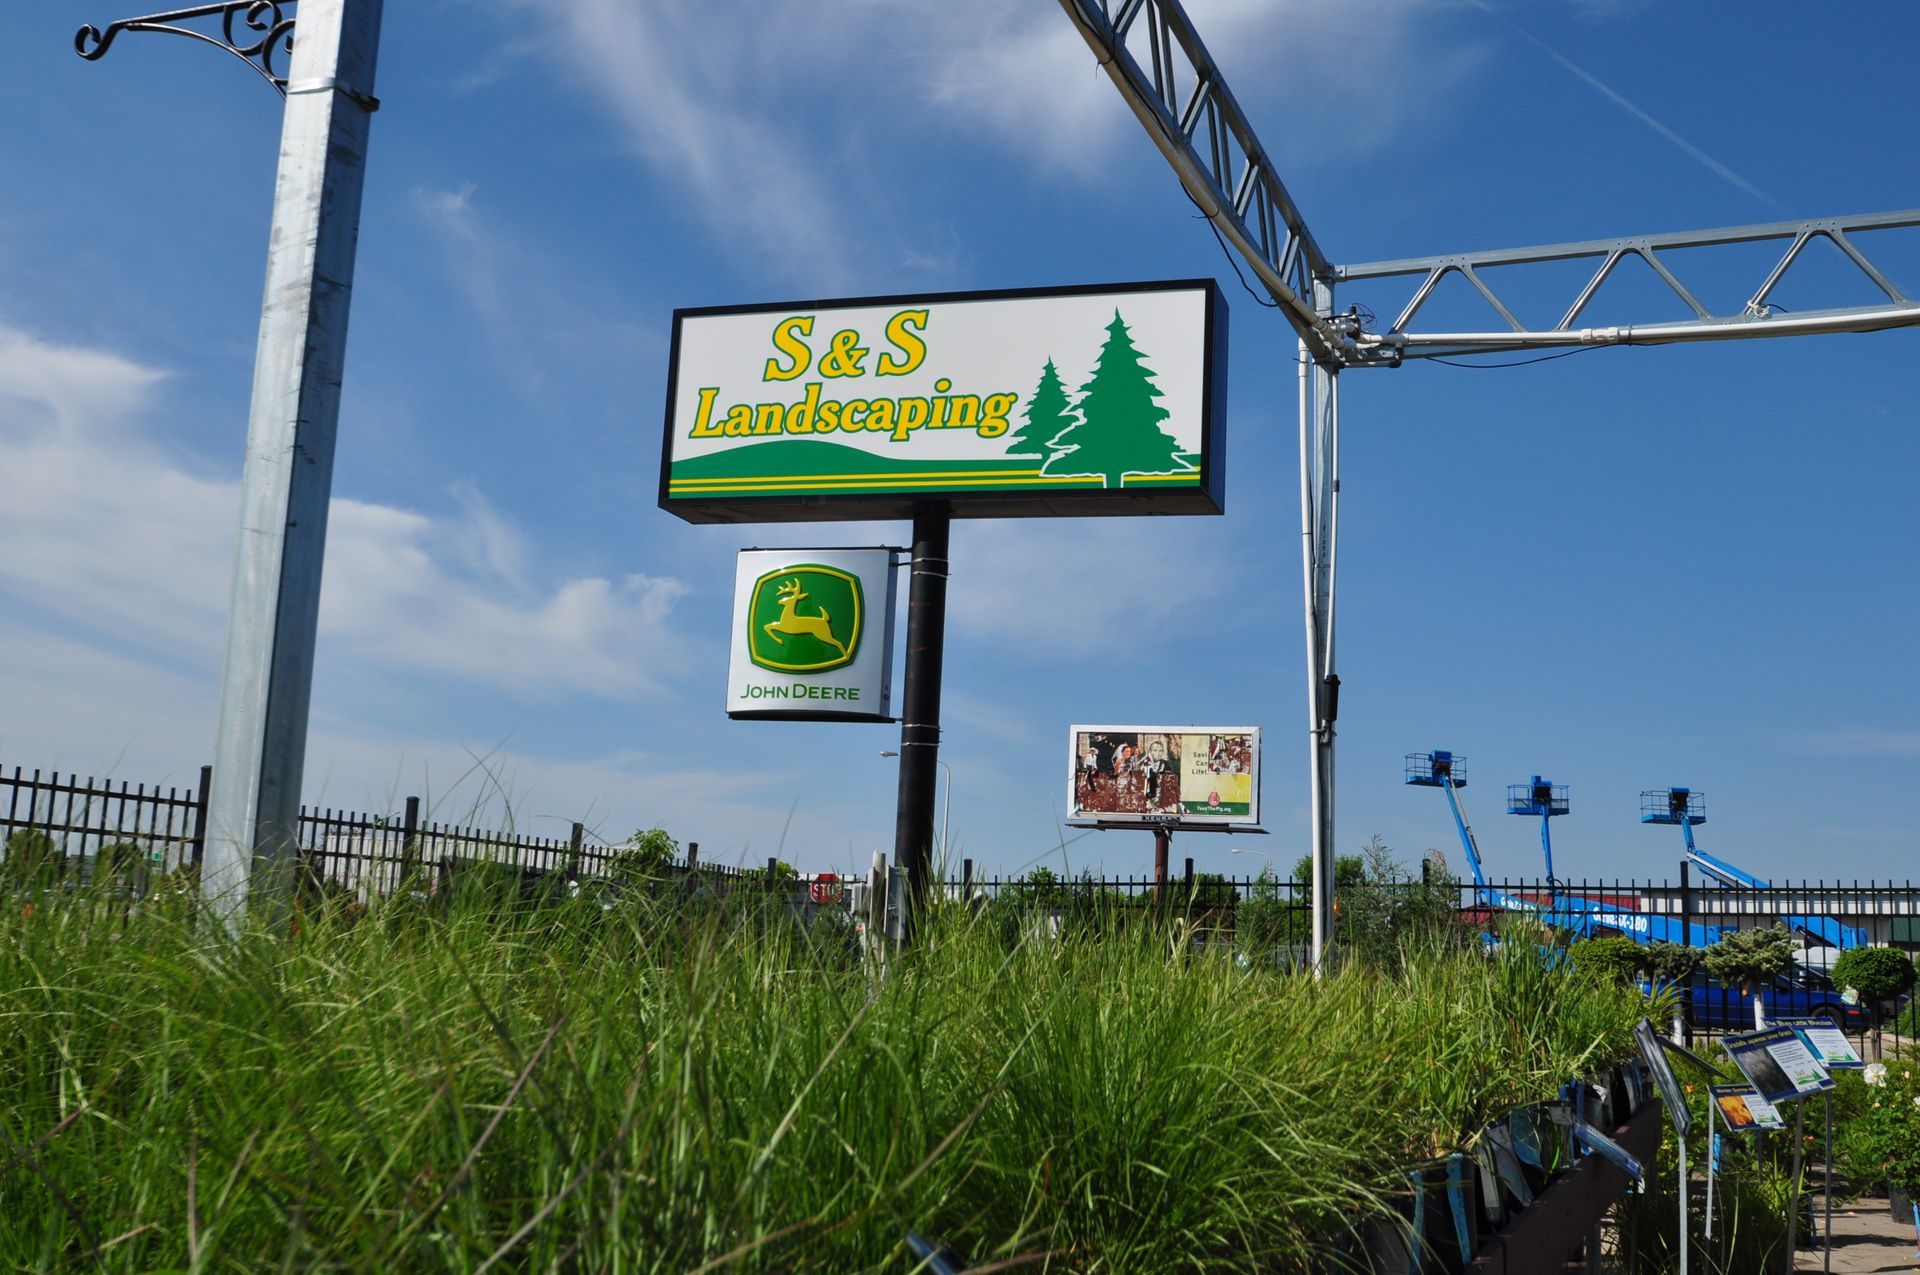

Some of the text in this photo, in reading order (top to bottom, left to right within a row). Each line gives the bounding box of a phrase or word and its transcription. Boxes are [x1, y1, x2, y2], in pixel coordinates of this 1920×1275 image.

[762, 309, 930, 382] S & S
[689, 378, 1018, 442] Landscaping
[740, 683, 860, 701] JOHN DEERE
